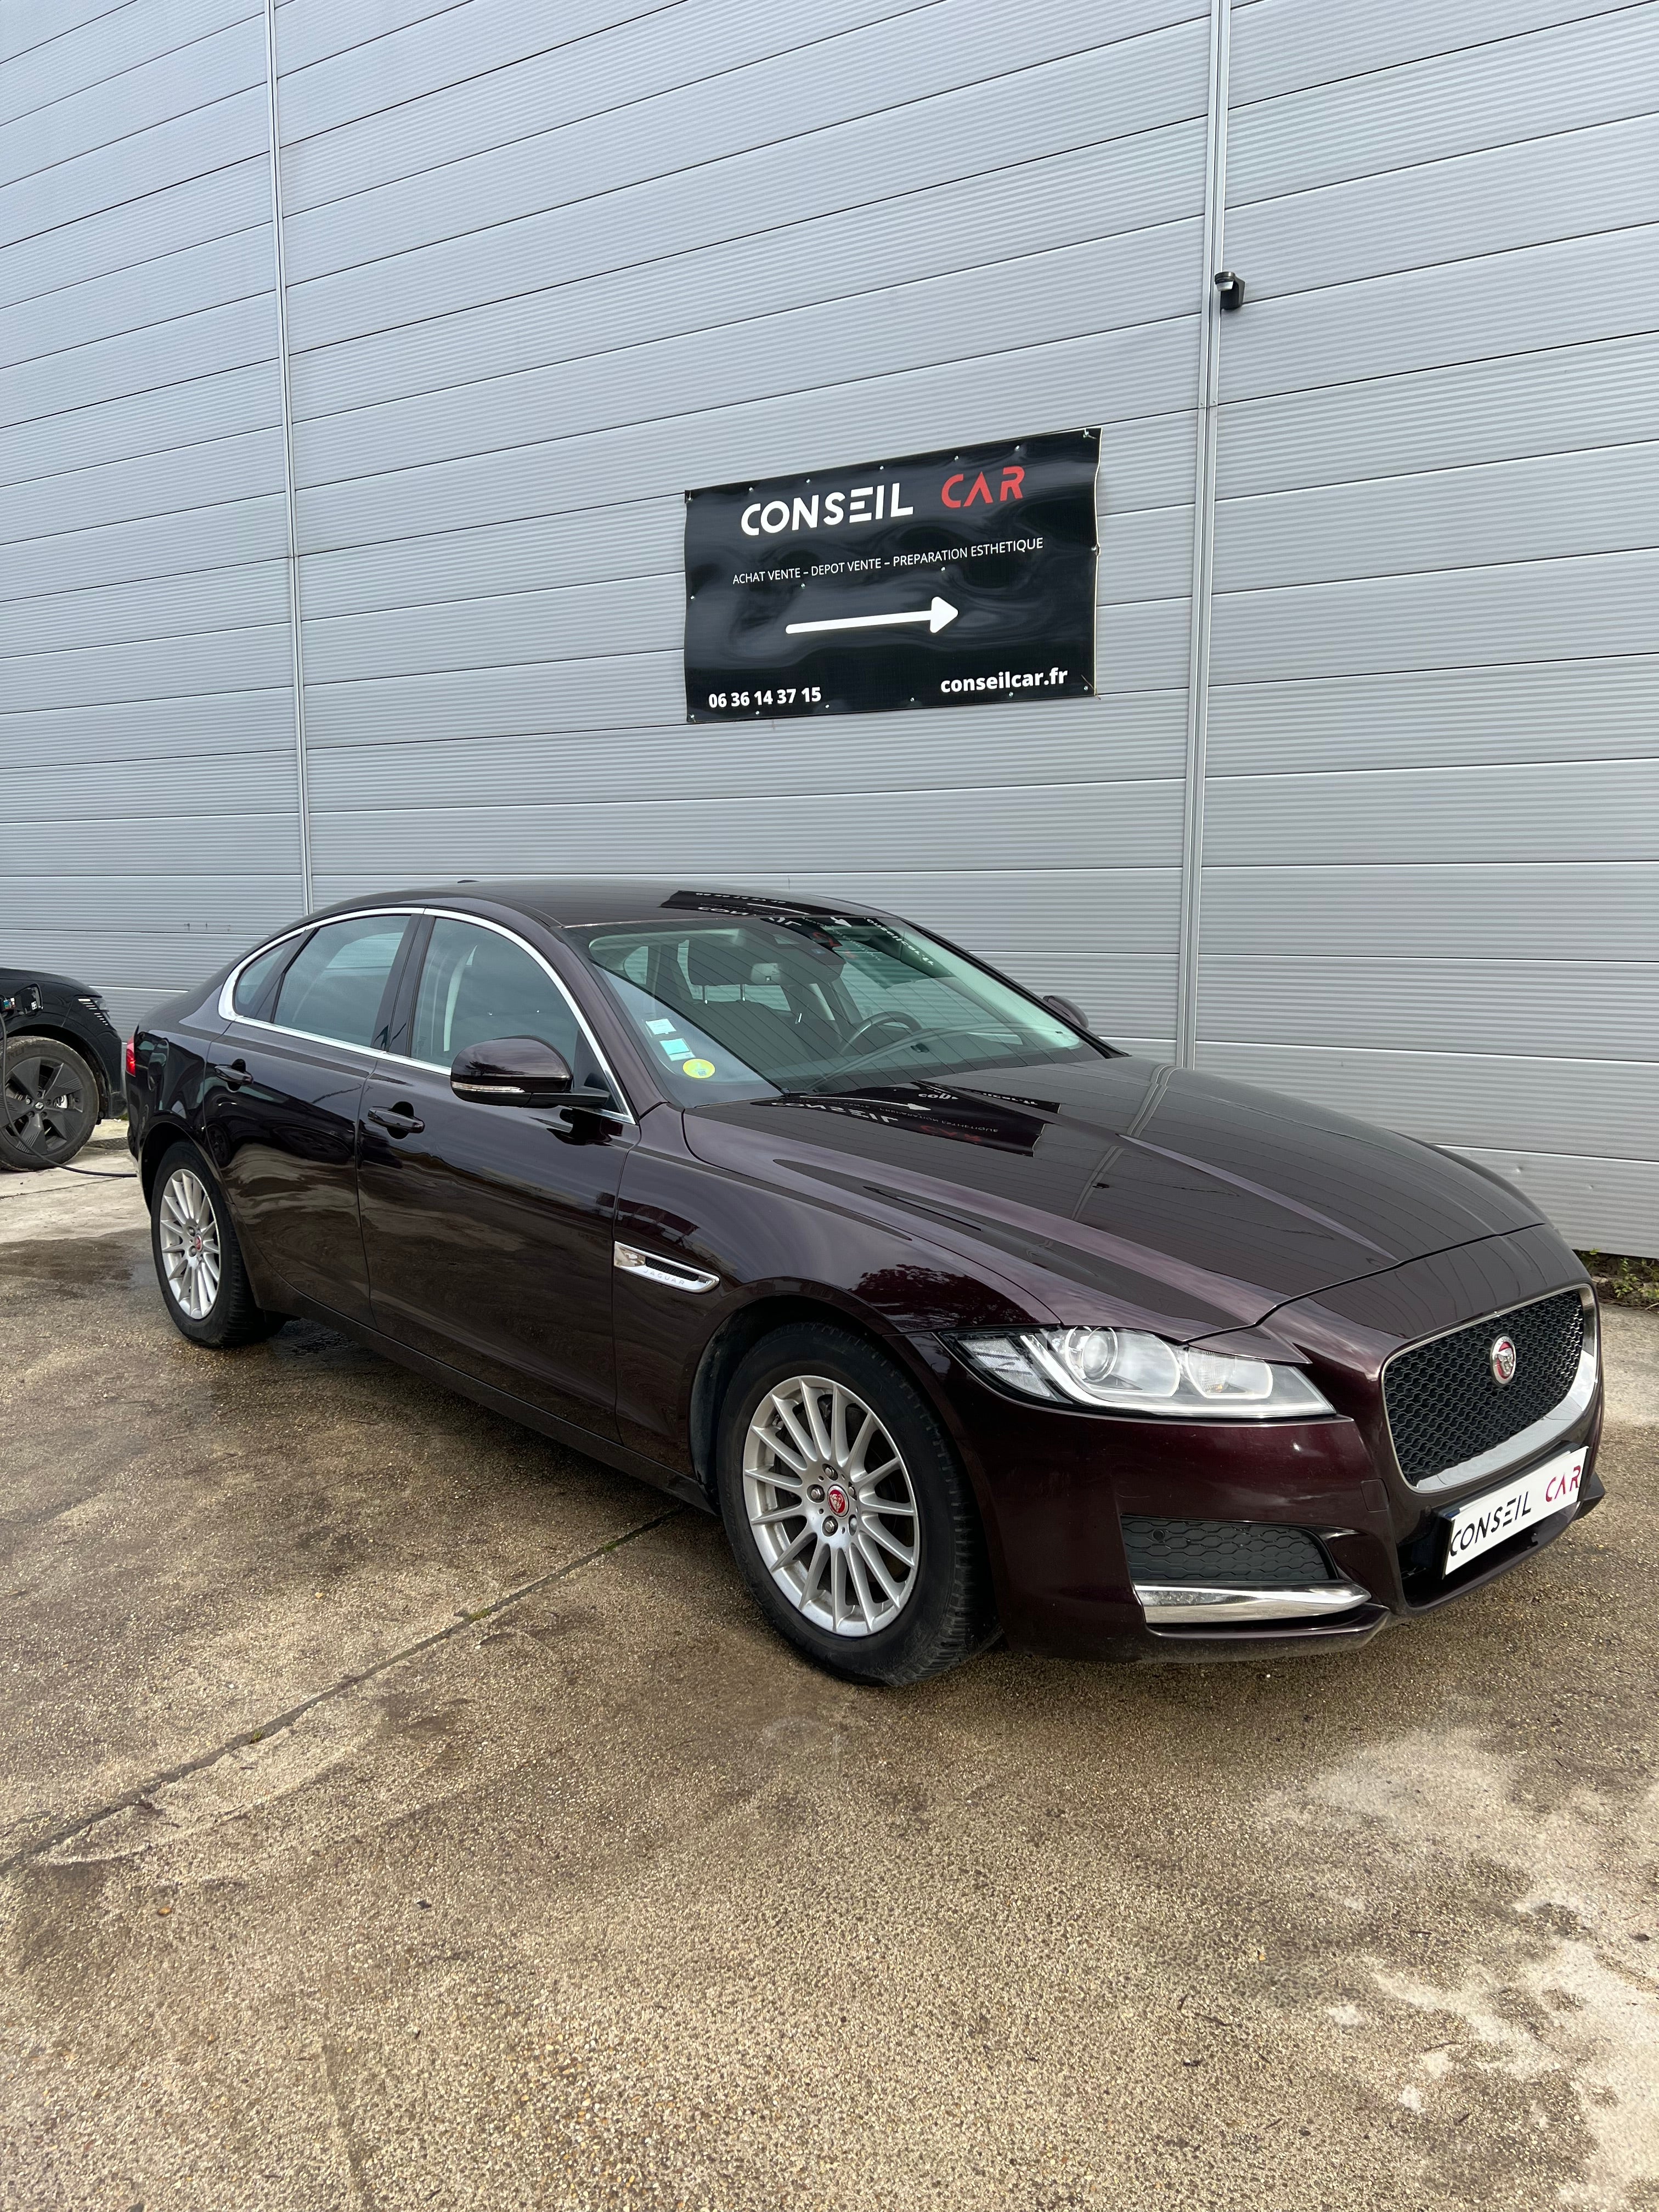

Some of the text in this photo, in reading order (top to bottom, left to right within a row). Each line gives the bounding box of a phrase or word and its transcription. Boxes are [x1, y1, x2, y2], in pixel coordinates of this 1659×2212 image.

[740, 465, 1026, 536] CONSEIL CAR
[732, 571, 766, 584] ACHAT
[768, 567, 801, 581] VENTE
[811, 562, 845, 577] DEPOT
[847, 557, 882, 572] VENTE
[893, 547, 968, 567] PREPARATION
[970, 537, 1043, 557] ESTHETIQUE
[708, 686, 822, 708] 06 36 14 37 15
[940, 667, 1068, 693] conseilcar.fr
[643, 1268, 685, 1285] JAGUAR
[1449, 1465, 1581, 1557] CONSEIL CAR
